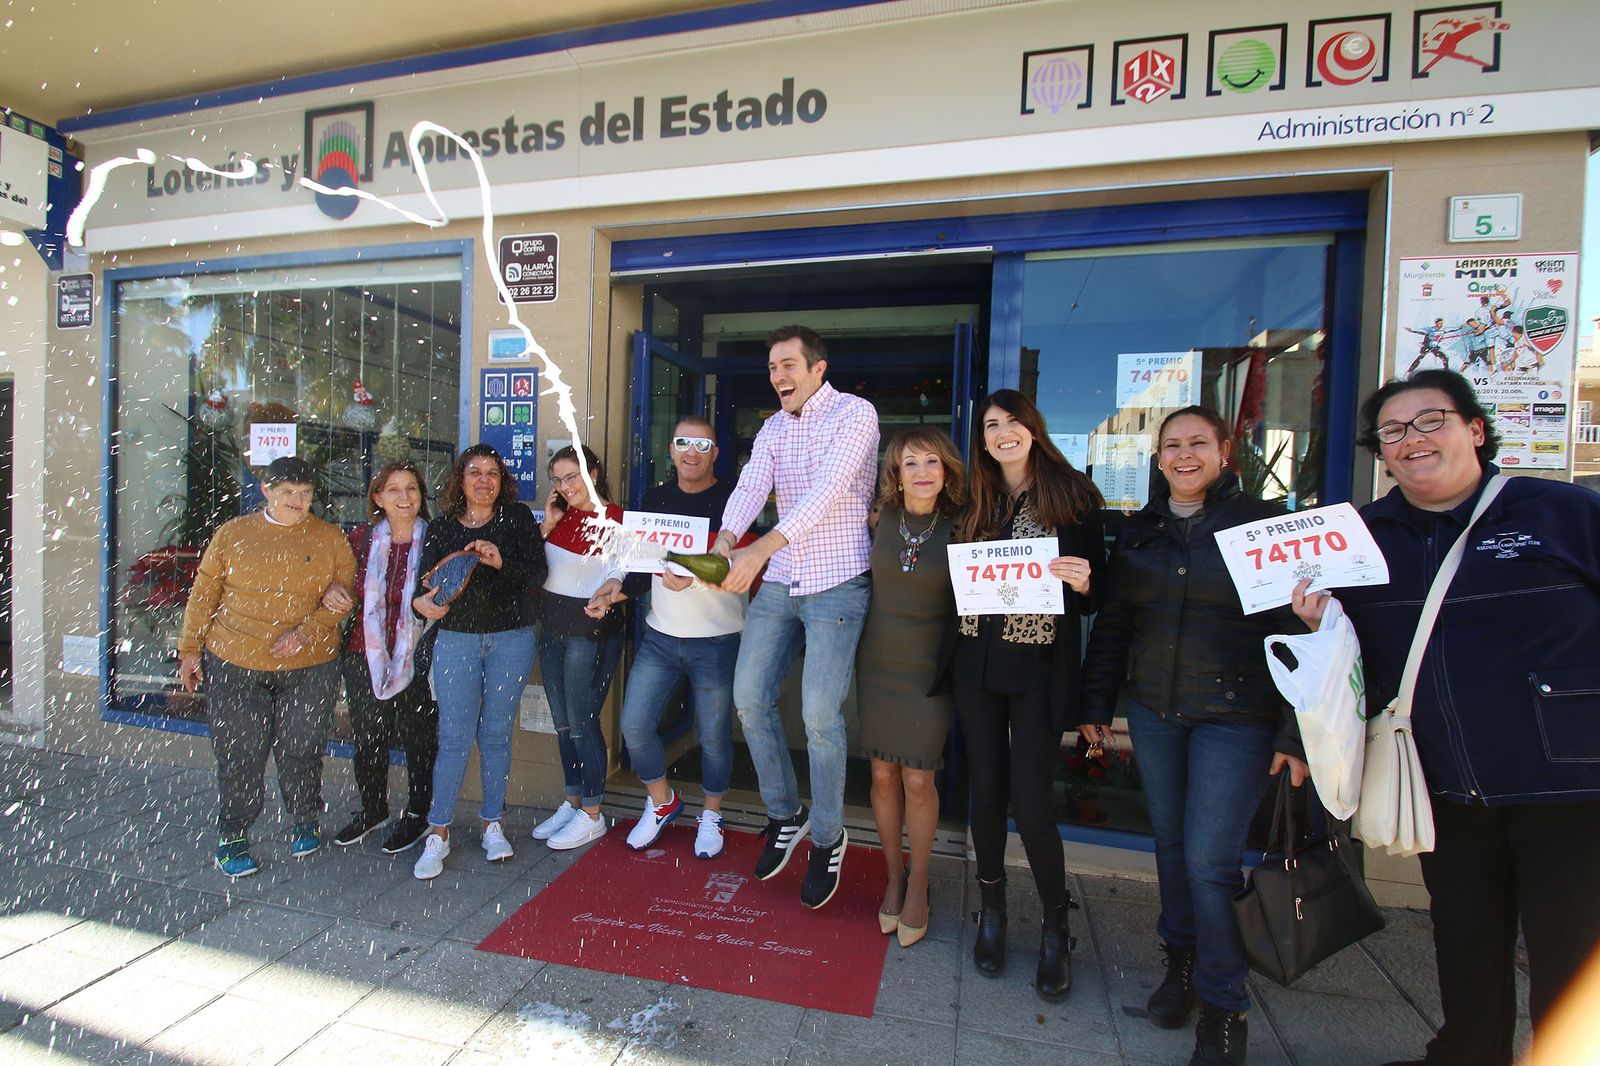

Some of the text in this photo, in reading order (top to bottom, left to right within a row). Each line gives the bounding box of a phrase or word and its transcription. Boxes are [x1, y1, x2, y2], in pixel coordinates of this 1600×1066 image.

[1257, 108, 1440, 142] Administración
[1479, 103, 1494, 125] 2
[281, 154, 299, 192] y
[383, 115, 565, 174] Apuestas
[580, 96, 645, 146] del
[660, 77, 827, 139] Estado
[12, 194, 28, 206] del
[1475, 215, 1493, 235] 5
[523, 239, 542, 247] grupo
[523, 245, 545, 253] control
[522, 263, 553, 271] ALARMA
[1455, 258, 1518, 268] LAMPARAS
[1455, 268, 1517, 278] MIVI
[520, 287, 530, 295] 26
[532, 286, 542, 295] 22
[543, 286, 554, 294] 22
[1148, 357, 1183, 366] PREMIO
[1130, 369, 1188, 383] 74770
[1473, 377, 1488, 386] VS
[1534, 406, 1565, 414] imagen
[257, 436, 289, 447] 74770
[520, 471, 534, 481] del
[655, 518, 690, 529] PREMIO
[1265, 515, 1325, 537] PREMIO
[635, 530, 694, 549] 74770
[987, 545, 1033, 558] PREMIO
[1245, 531, 1348, 571] 74770
[966, 562, 1043, 582] 74770
[715, 905, 727, 913] de
[716, 933, 755, 947] Valor
[758, 941, 814, 956] Seguro
